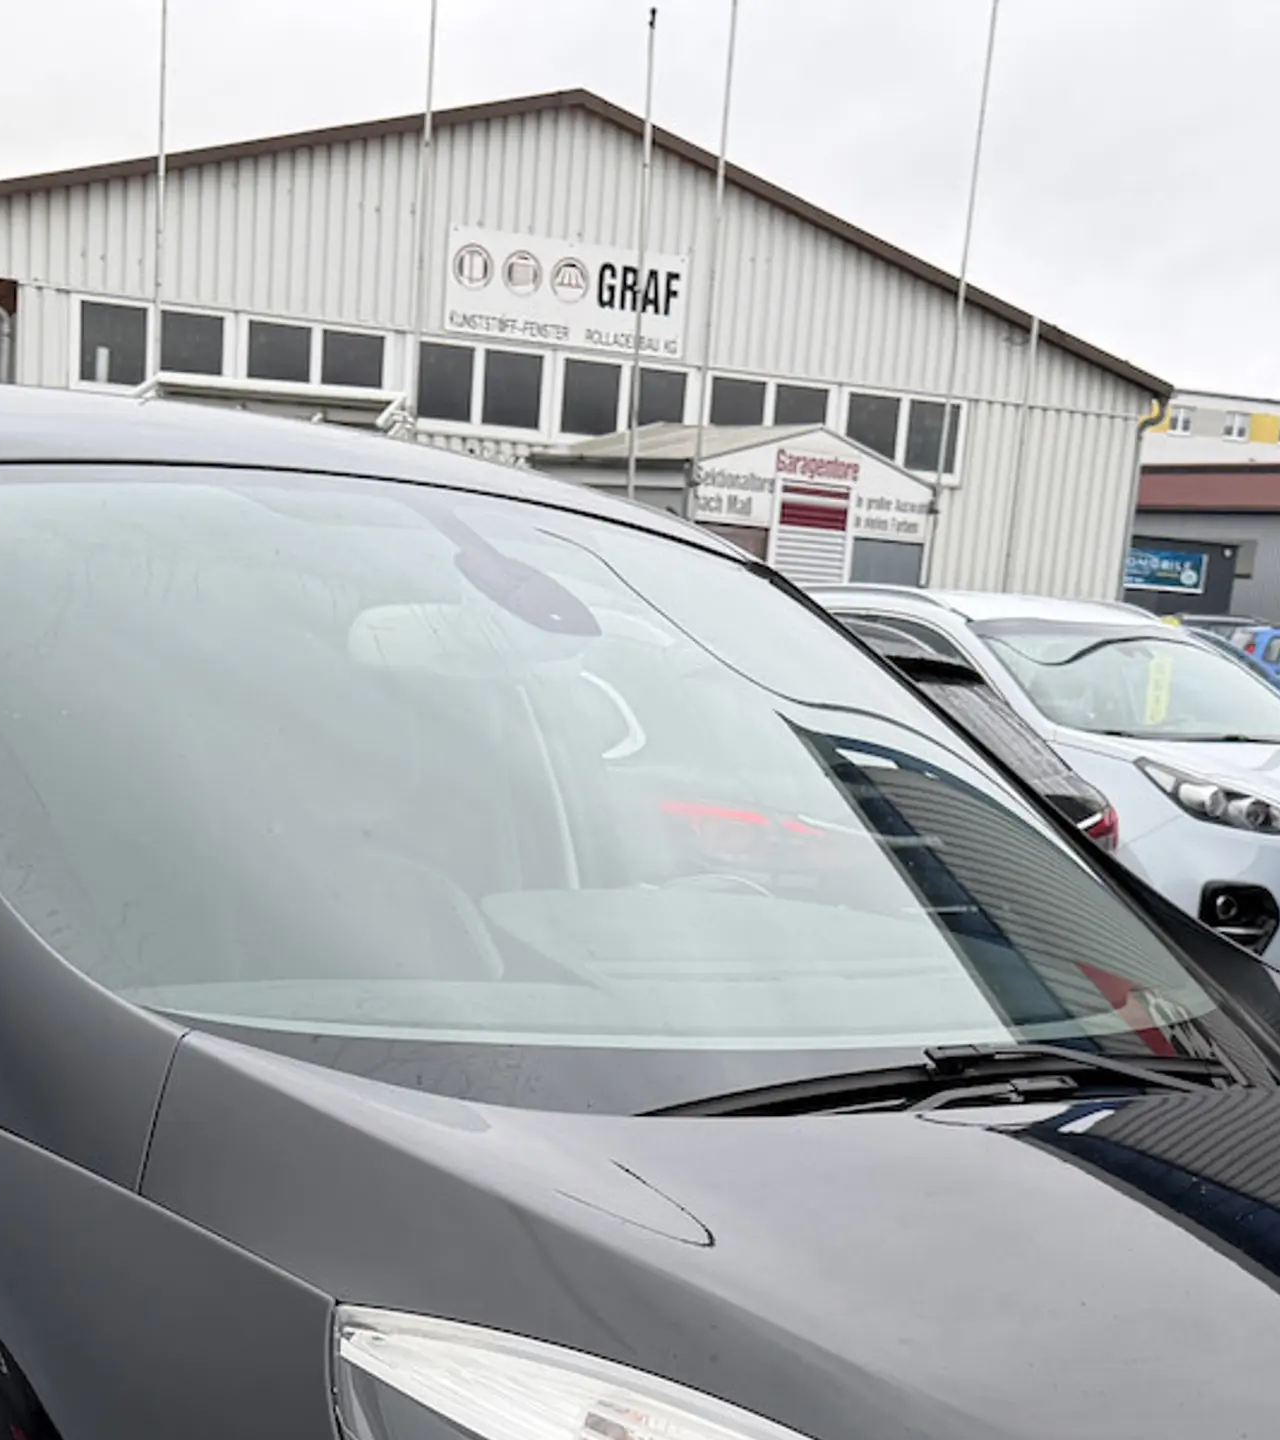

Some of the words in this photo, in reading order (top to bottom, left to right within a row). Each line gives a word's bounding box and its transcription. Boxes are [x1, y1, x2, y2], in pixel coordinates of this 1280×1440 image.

[597, 261, 681, 316] GRAF
[585, 328, 659, 352] ROLLADEBAU
[776, 448, 860, 483] Garagentore
